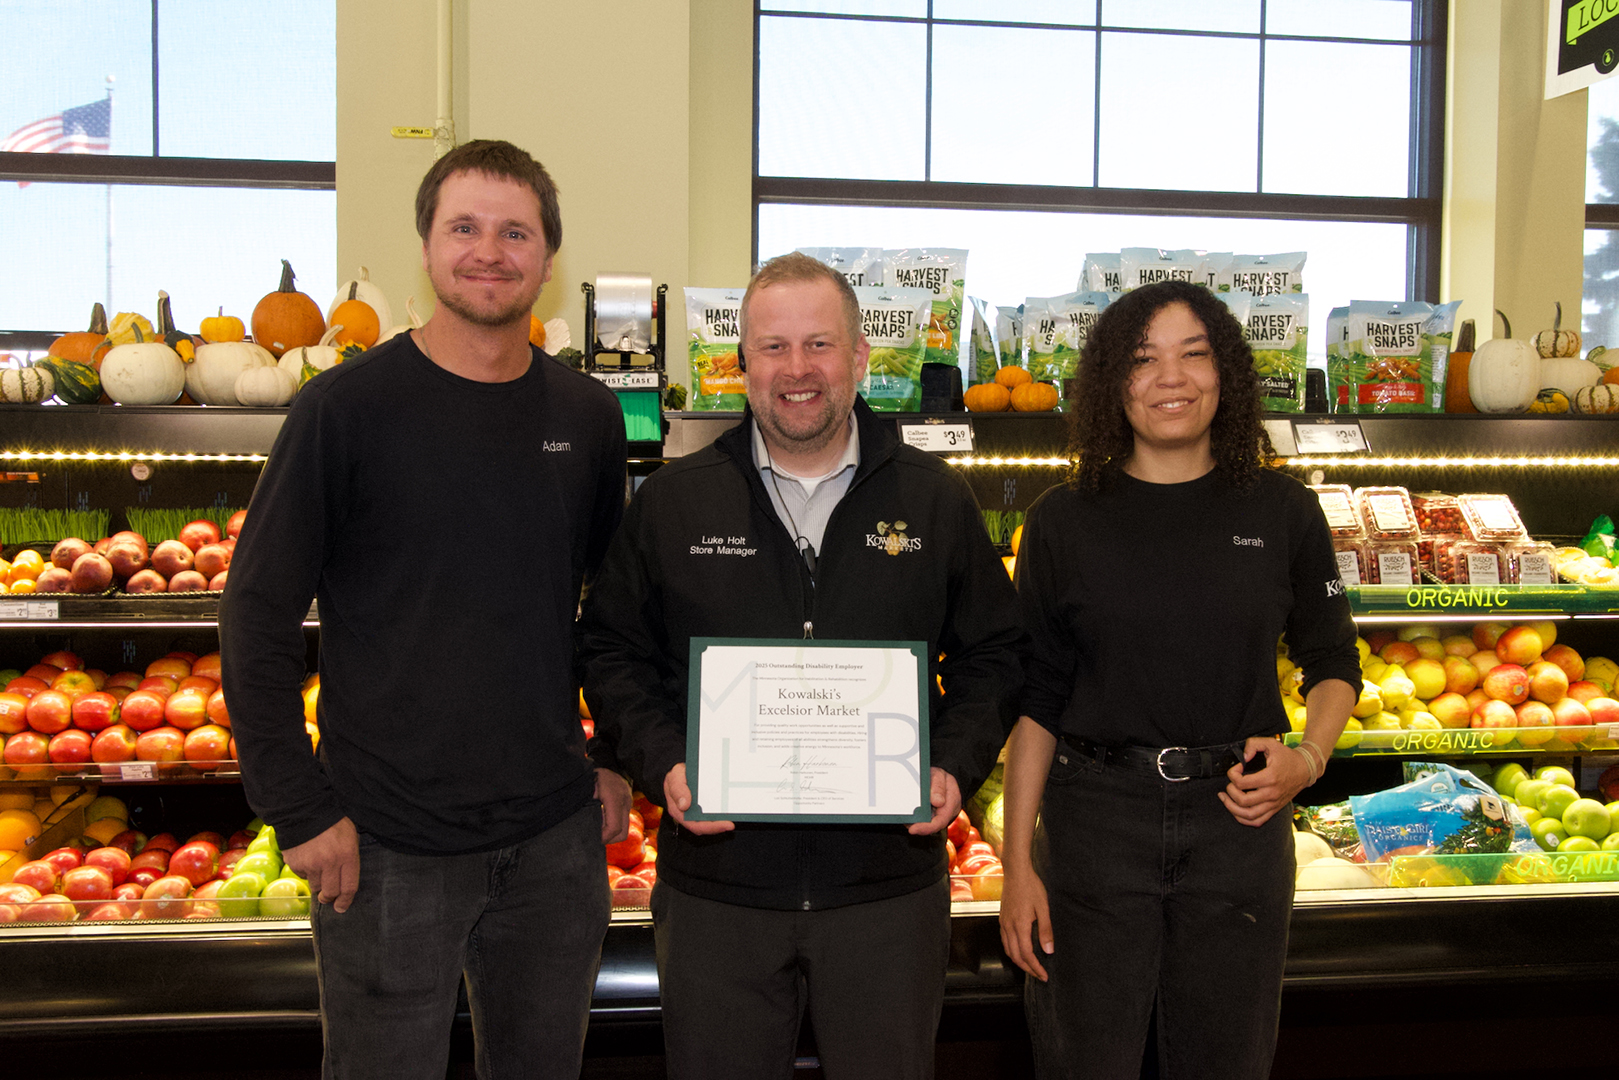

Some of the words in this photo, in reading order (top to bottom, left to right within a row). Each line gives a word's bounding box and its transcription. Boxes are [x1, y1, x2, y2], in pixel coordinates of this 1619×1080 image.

[896, 267, 949, 283] HARVEST
[1139, 269, 1193, 284] HARVEST
[705, 308, 741, 325] HARV
[1070, 312, 1100, 327] HARV
[863, 323, 905, 339] SNAPS
[1245, 328, 1286, 341] SNAPS
[1367, 321, 1421, 337] HARVEST
[1375, 335, 1415, 348] SNAPS
[1266, 381, 1290, 389] SALTED
[542, 440, 571, 452] Adam
[701, 535, 724, 545] Luke
[727, 536, 746, 546] Holt
[1232, 535, 1264, 548] Sarah
[690, 545, 714, 555] Store
[716, 545, 758, 558] Manager
[1406, 588, 1509, 607] ORGANIC
[769, 662, 804, 670] Outstanding
[835, 663, 864, 671] Employer
[778, 687, 842, 700] Kowalski's
[758, 703, 813, 716] Excelsior
[816, 704, 860, 717] Market
[1392, 731, 1494, 751] ORGANIC
[1378, 834, 1424, 842] ORGANICS
[1516, 854, 1619, 877] ORGANI
